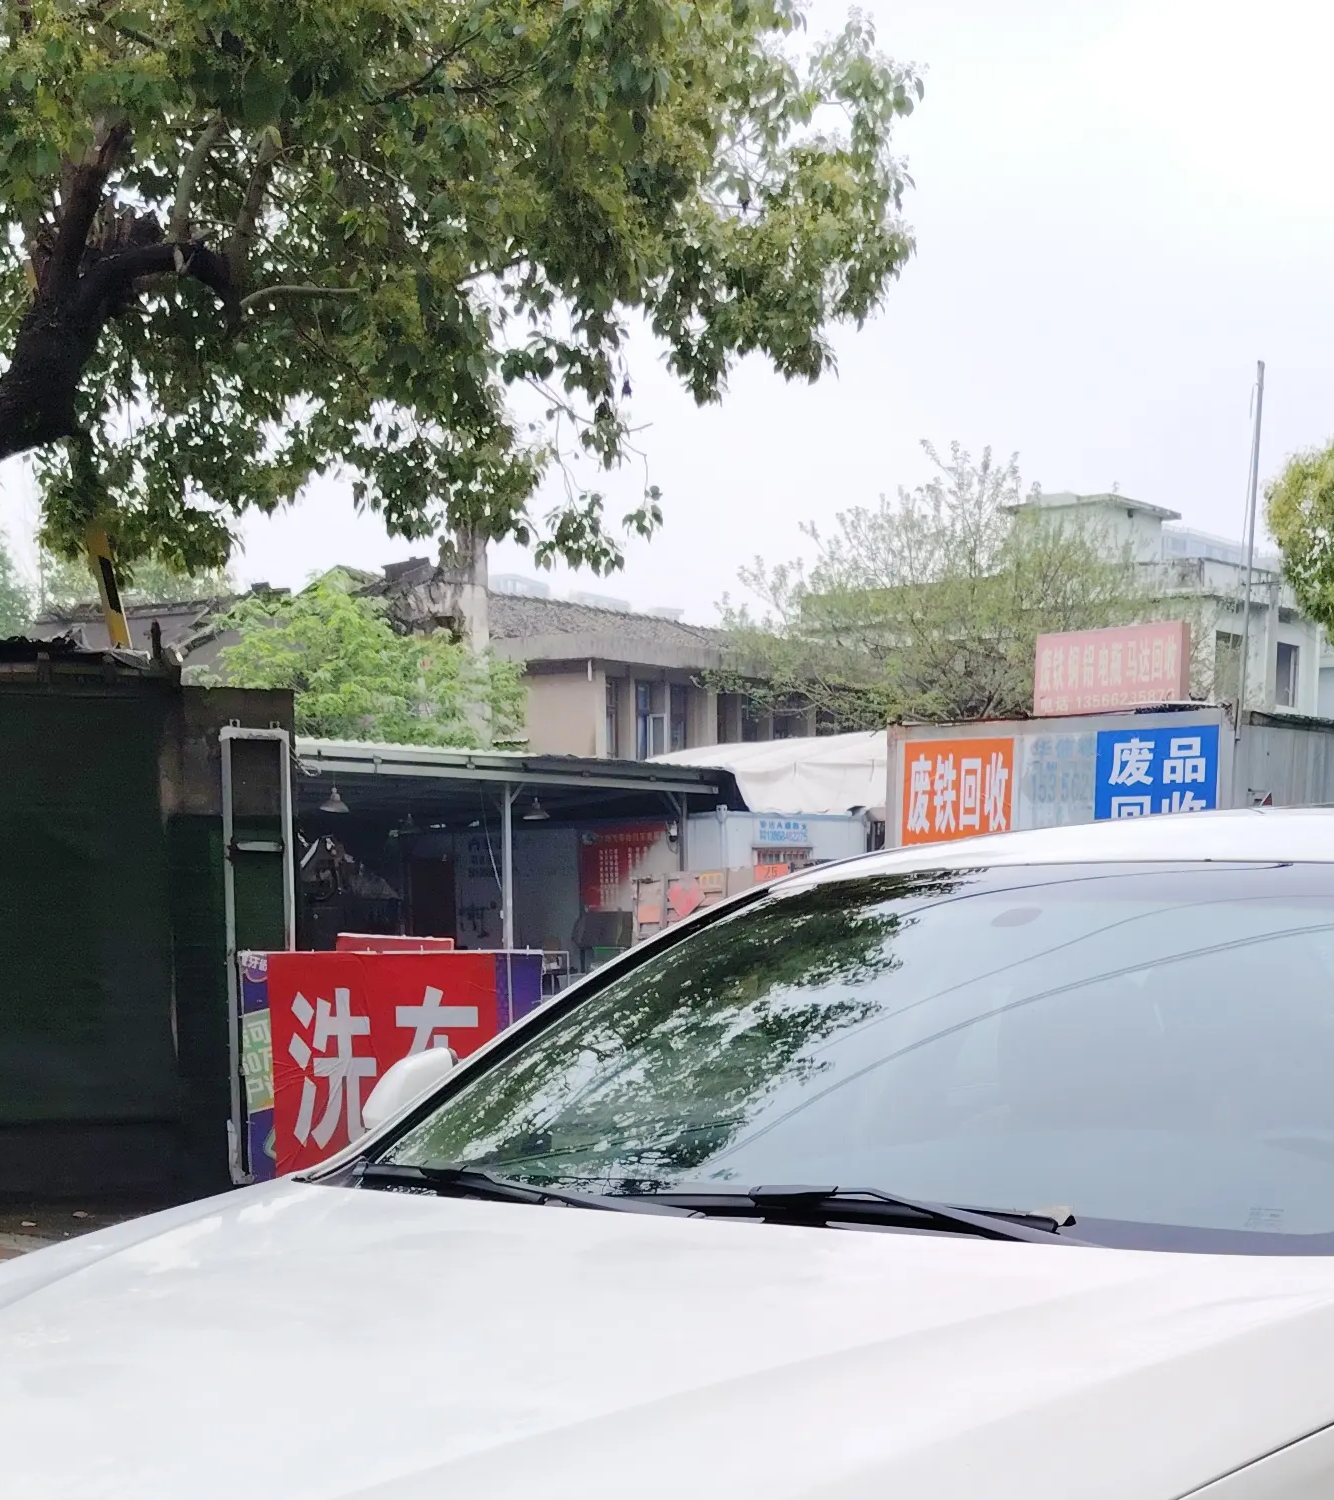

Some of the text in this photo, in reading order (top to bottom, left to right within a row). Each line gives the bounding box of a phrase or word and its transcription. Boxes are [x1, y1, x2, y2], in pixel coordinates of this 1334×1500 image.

[907, 752, 1008, 833] 废铁回收
[1108, 737, 1206, 786] 废品
